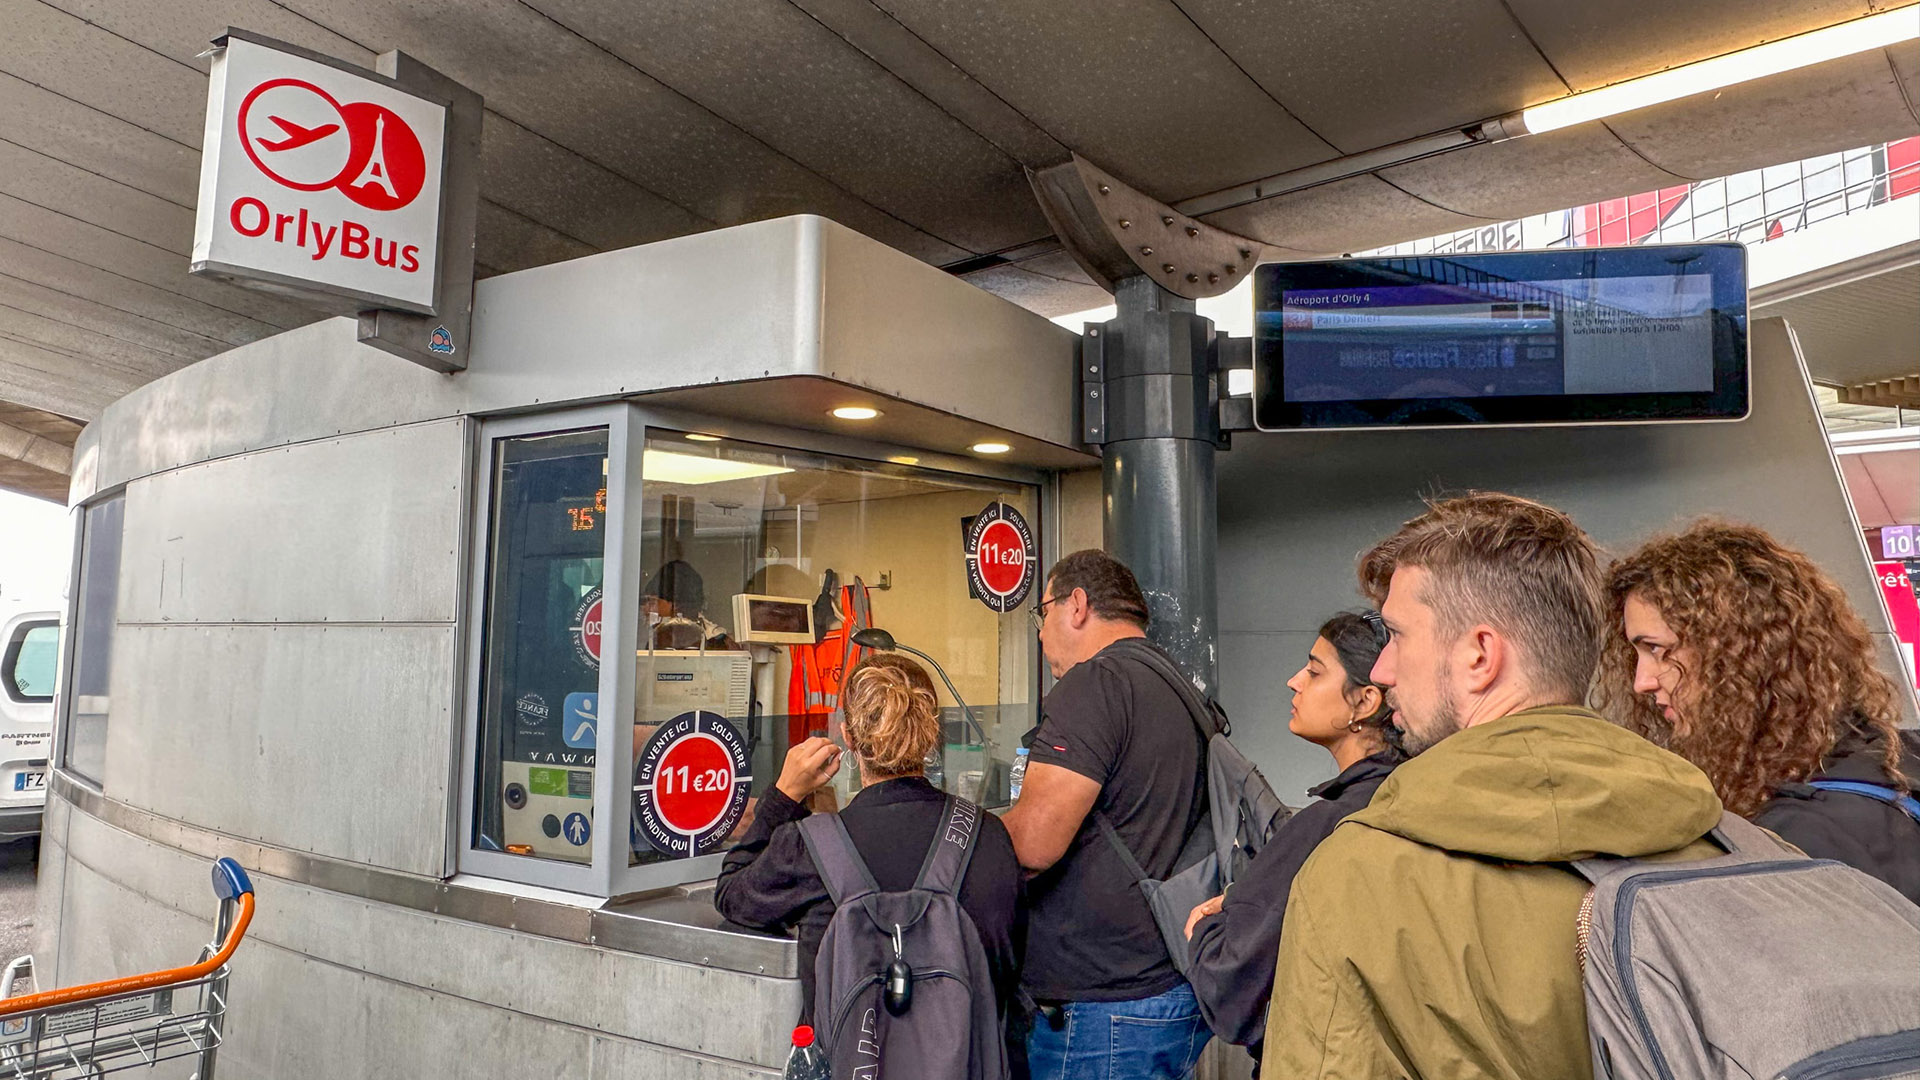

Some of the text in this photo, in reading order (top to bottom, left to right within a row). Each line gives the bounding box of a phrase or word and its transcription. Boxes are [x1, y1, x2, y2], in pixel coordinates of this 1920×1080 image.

[230, 196, 420, 273] OrlyBus
[1287, 293, 1370, 307] Aéroport d'Orly 4
[970, 509, 997, 551] EN VENTE ICI
[1009, 512, 1023, 529] SOLD
[981, 542, 1023, 566] 11€20
[1886, 535, 1911, 554] 10
[641, 720, 689, 780] EN VENTE ICI
[710, 721, 746, 769] SOLD HERE
[26, 772, 45, 787] FZ
[661, 765, 729, 794] 11€20
[640, 793, 688, 851] IN VENDITA QUI
[945, 798, 976, 849] IKE
